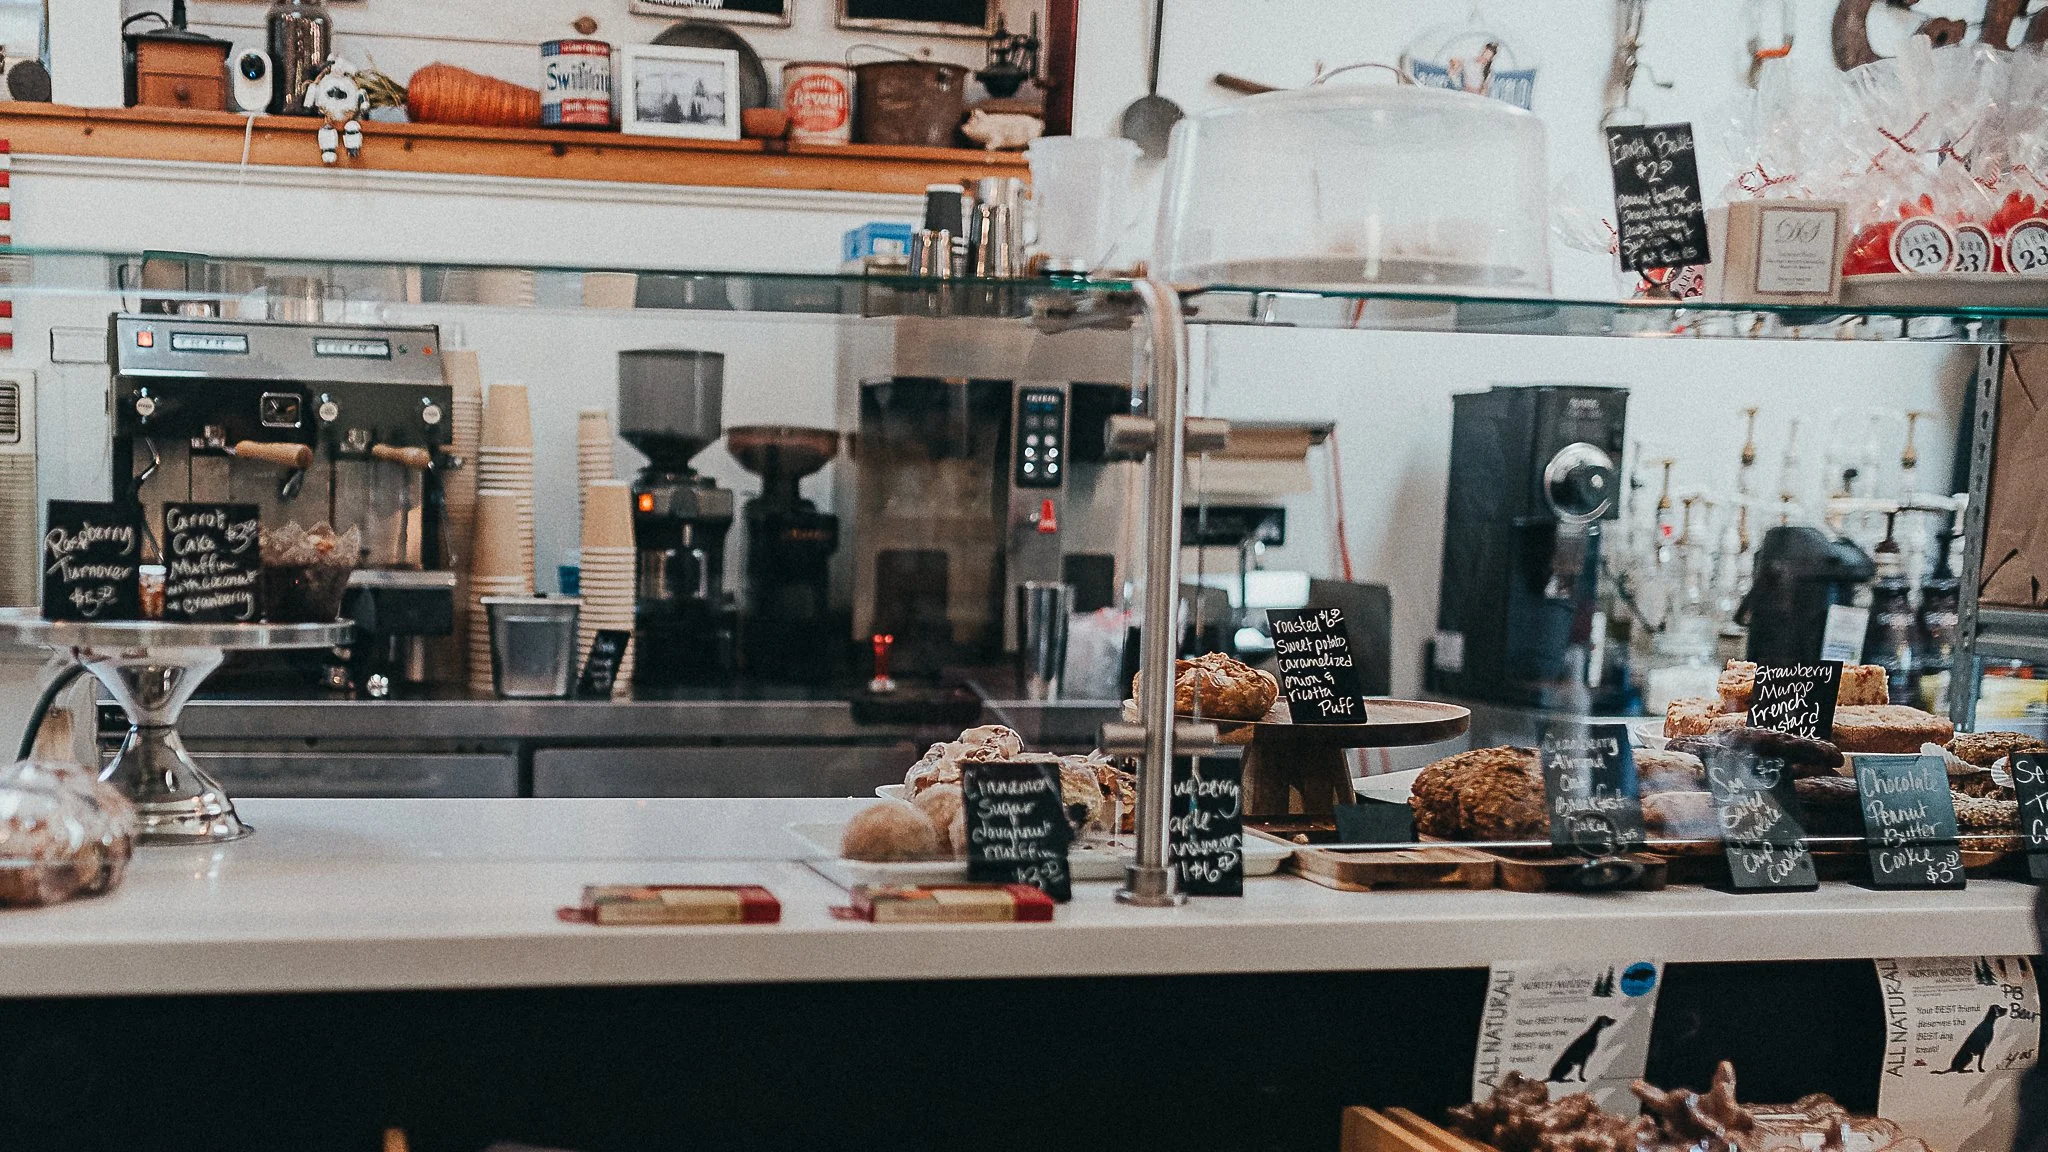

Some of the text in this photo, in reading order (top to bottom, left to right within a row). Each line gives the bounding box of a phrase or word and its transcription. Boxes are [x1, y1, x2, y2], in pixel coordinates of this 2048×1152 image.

[1908, 244, 1943, 267] 23
[166, 508, 226, 533] Carrot
[1273, 615, 1321, 634] roasted
[1284, 671, 1321, 688] onion
[1756, 662, 1833, 684] Strawberry
[1288, 686, 1334, 702] ricotta
[1758, 681, 1814, 701] Mango
[1751, 692, 1808, 726] French
[1861, 766, 1939, 799] Chocolate
[1867, 800, 1930, 827] Peanut
[1883, 821, 1943, 848] Butter
[1879, 848, 1937, 874] Cookie
[1885, 1046, 1907, 1078] ALL
